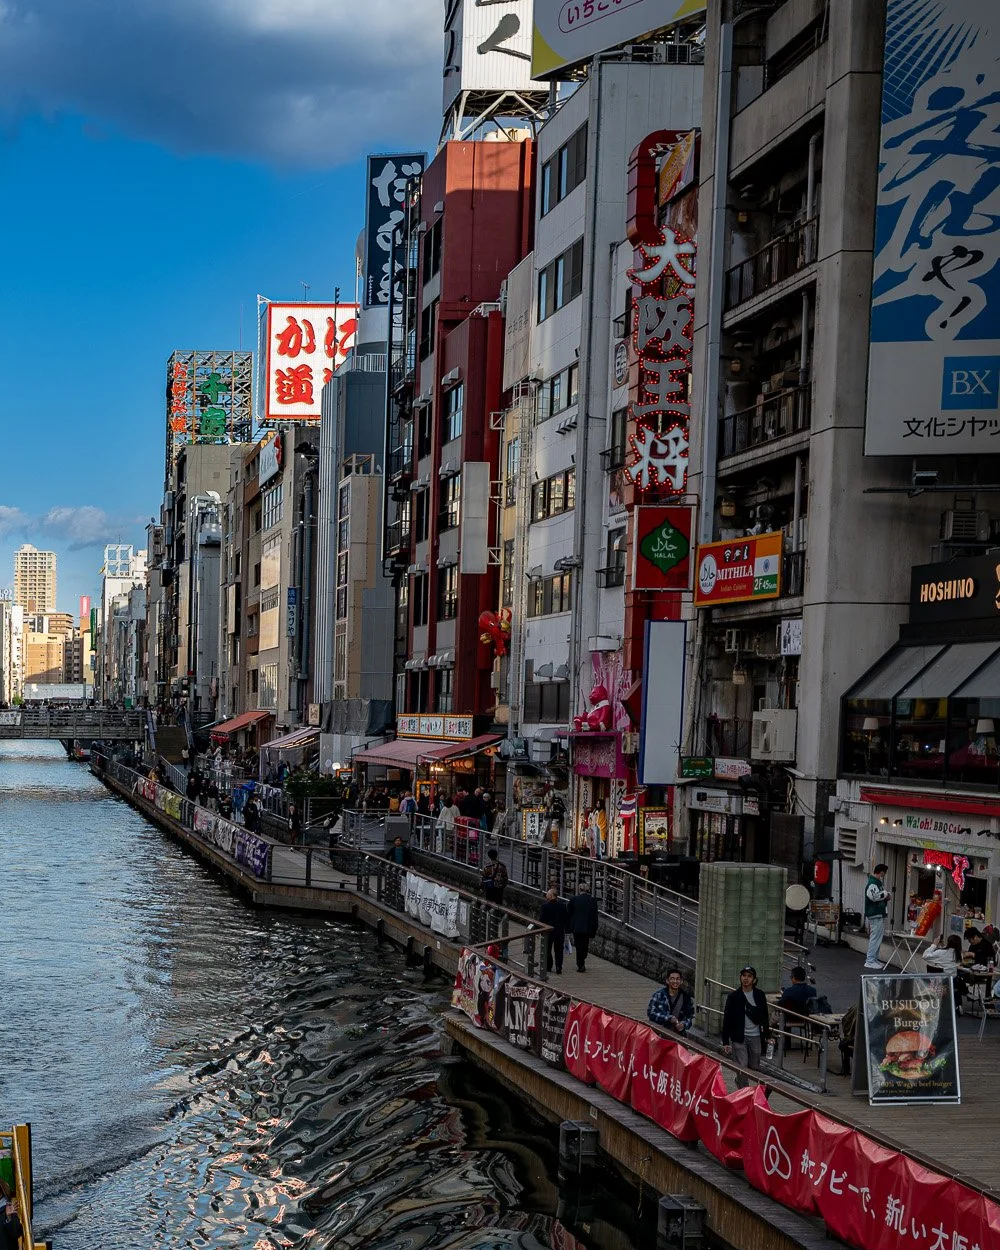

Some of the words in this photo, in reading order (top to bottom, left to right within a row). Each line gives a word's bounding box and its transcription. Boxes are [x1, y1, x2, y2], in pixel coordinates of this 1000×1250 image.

[276, 316, 357, 358] かに
[627, 224, 697, 493] 大阪王将
[949, 369, 992, 395] BX
[651, 537, 678, 552] حلال
[717, 565, 753, 580] MITHILA
[754, 578, 763, 590] 2F
[920, 577, 974, 603] HOSHINO
[933, 821, 948, 834] BBQ
[881, 999, 940, 1010] BUSIDOU
[893, 1016, 928, 1030] Burger
